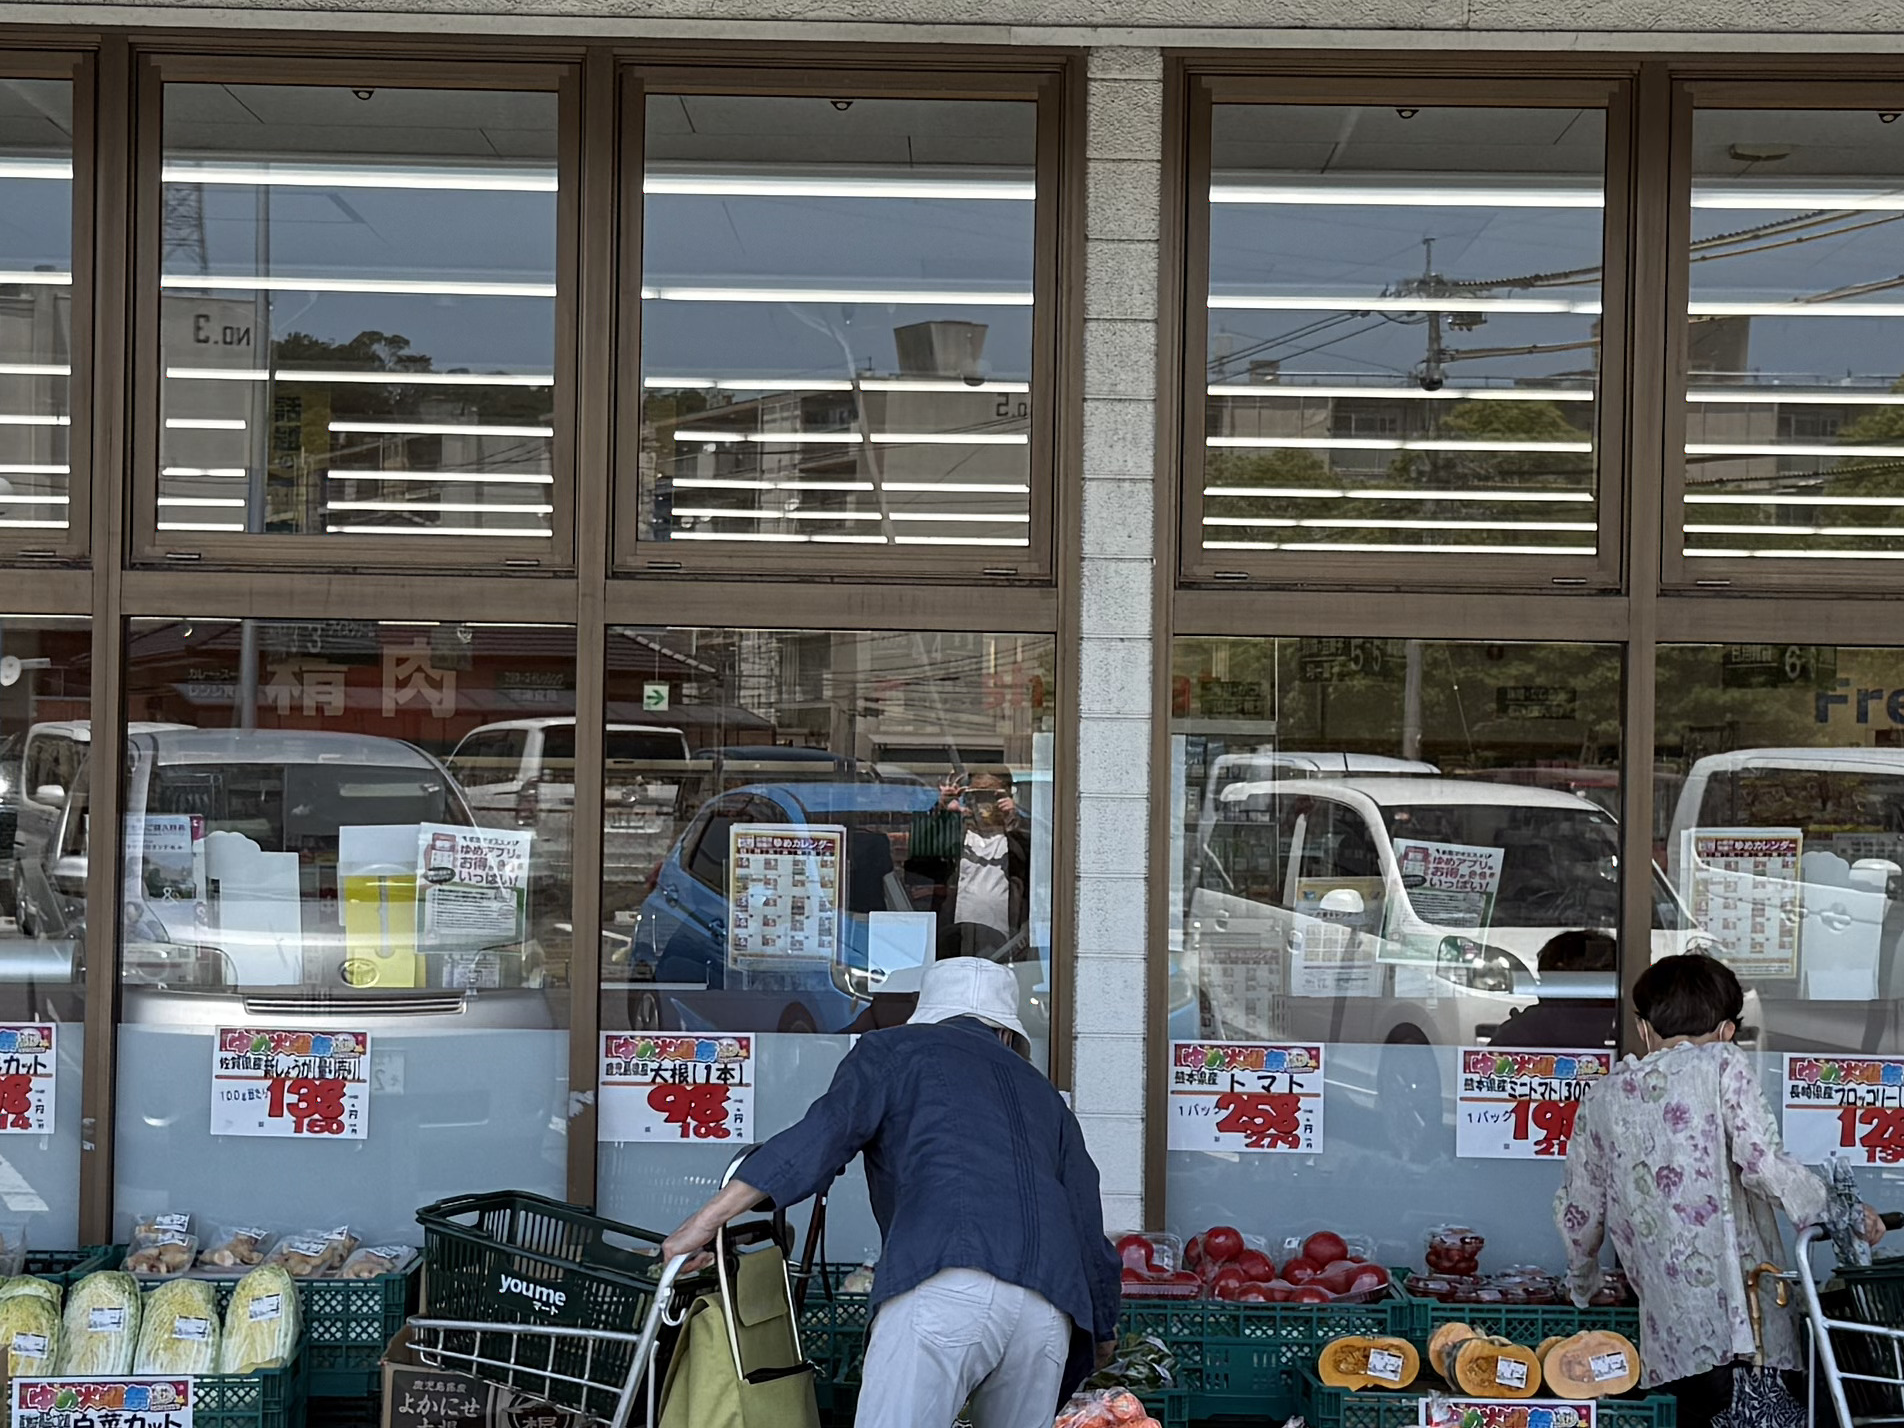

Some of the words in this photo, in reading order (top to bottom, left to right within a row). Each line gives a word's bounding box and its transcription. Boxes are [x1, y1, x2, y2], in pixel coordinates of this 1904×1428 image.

[266, 1077, 347, 1120] 138
[1229, 1073, 1305, 1095] トマト
[647, 1084, 732, 1124] 98
[1215, 1093, 1302, 1135] 258
[498, 1273, 567, 1306] youme
[532, 1300, 559, 1316] マート
[398, 1392, 481, 1418] よかにせ
